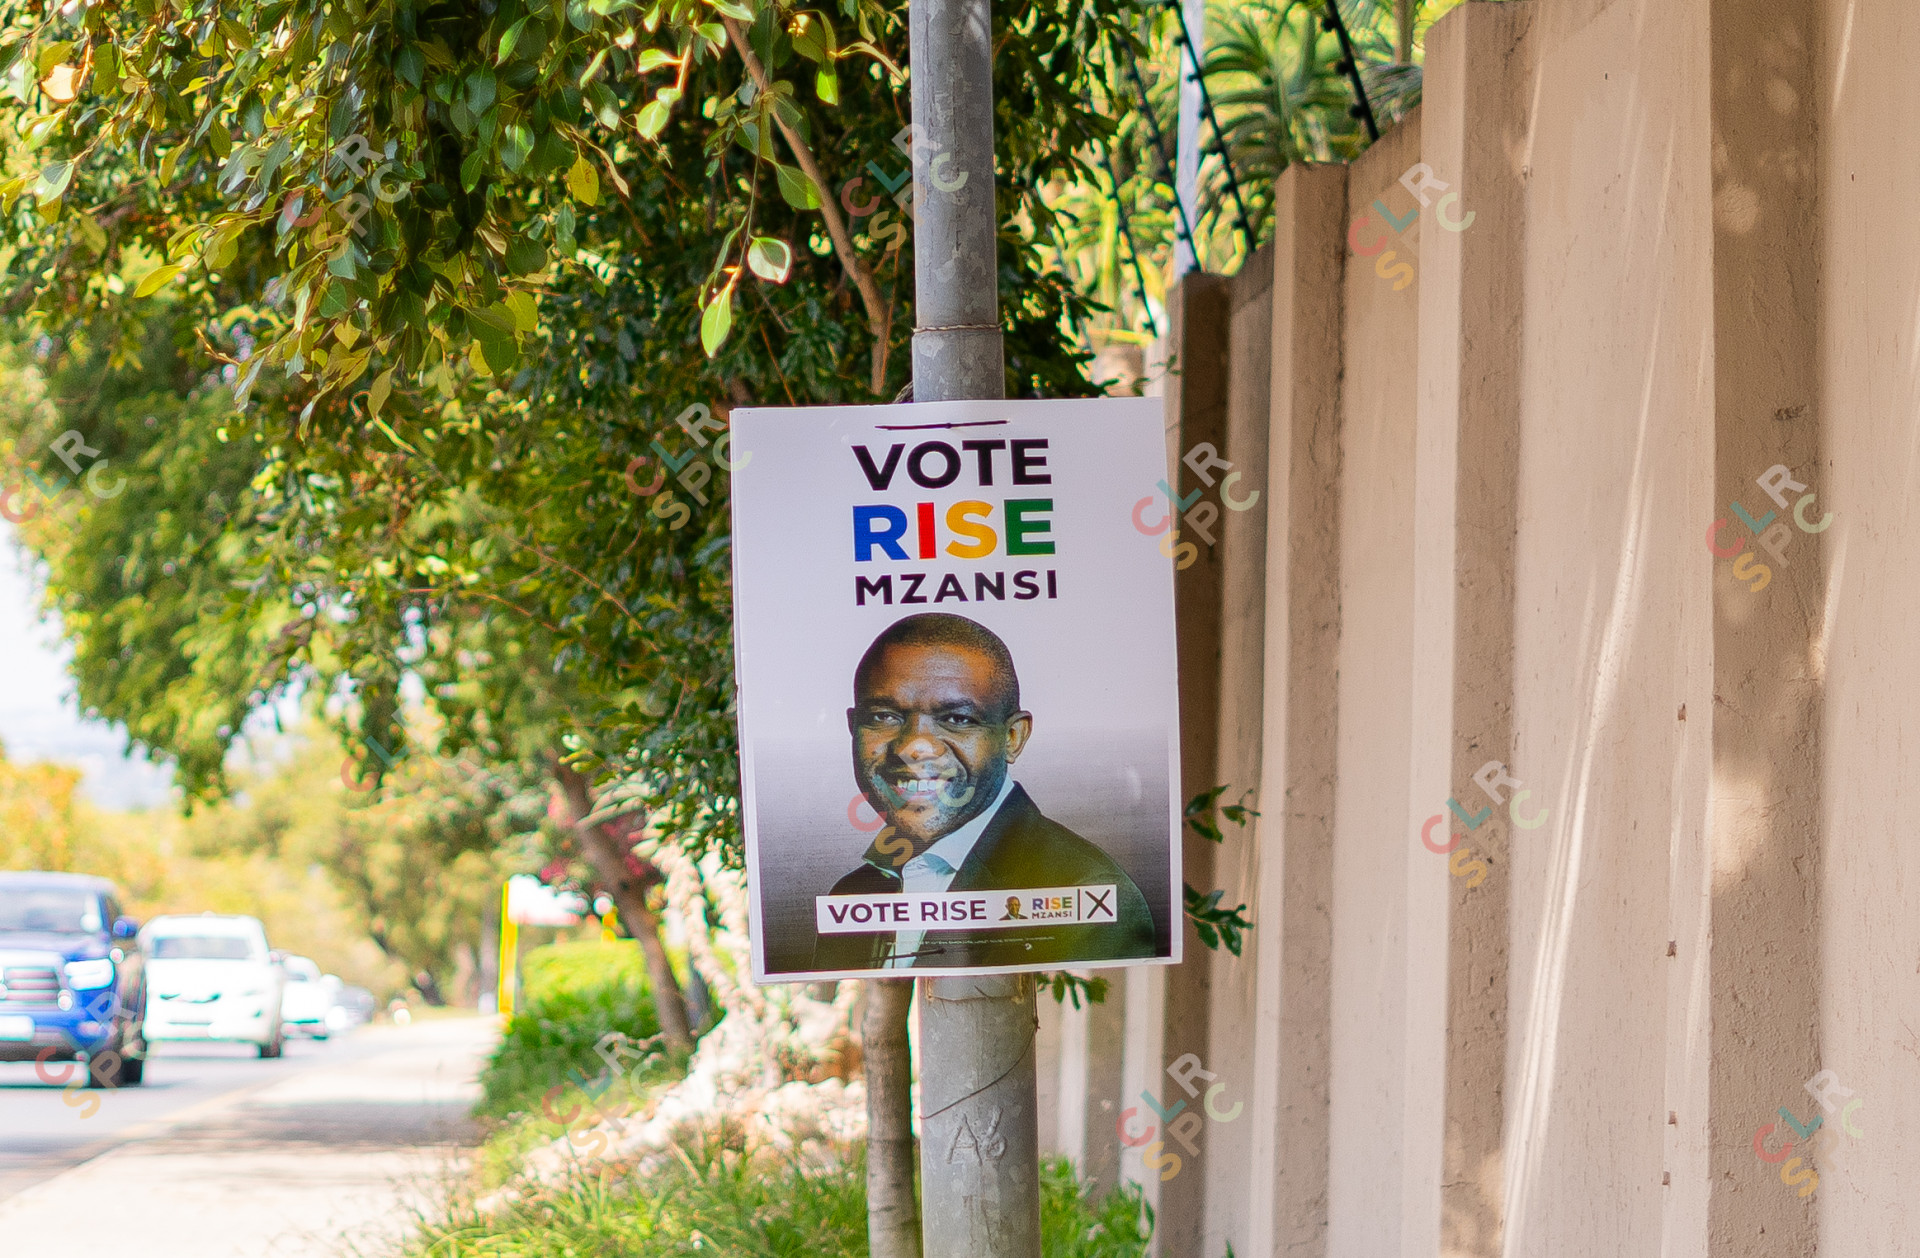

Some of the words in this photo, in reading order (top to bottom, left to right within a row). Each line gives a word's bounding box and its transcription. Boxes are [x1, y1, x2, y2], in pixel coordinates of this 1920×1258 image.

[852, 438, 1052, 491] VOTE
[853, 498, 1056, 562] RISE
[855, 570, 1058, 606] MZANSI
[827, 902, 910, 924] VOTE
[921, 899, 987, 922] RISE
[1031, 911, 1073, 920] MZANSI
[1032, 896, 1073, 910] RISE
